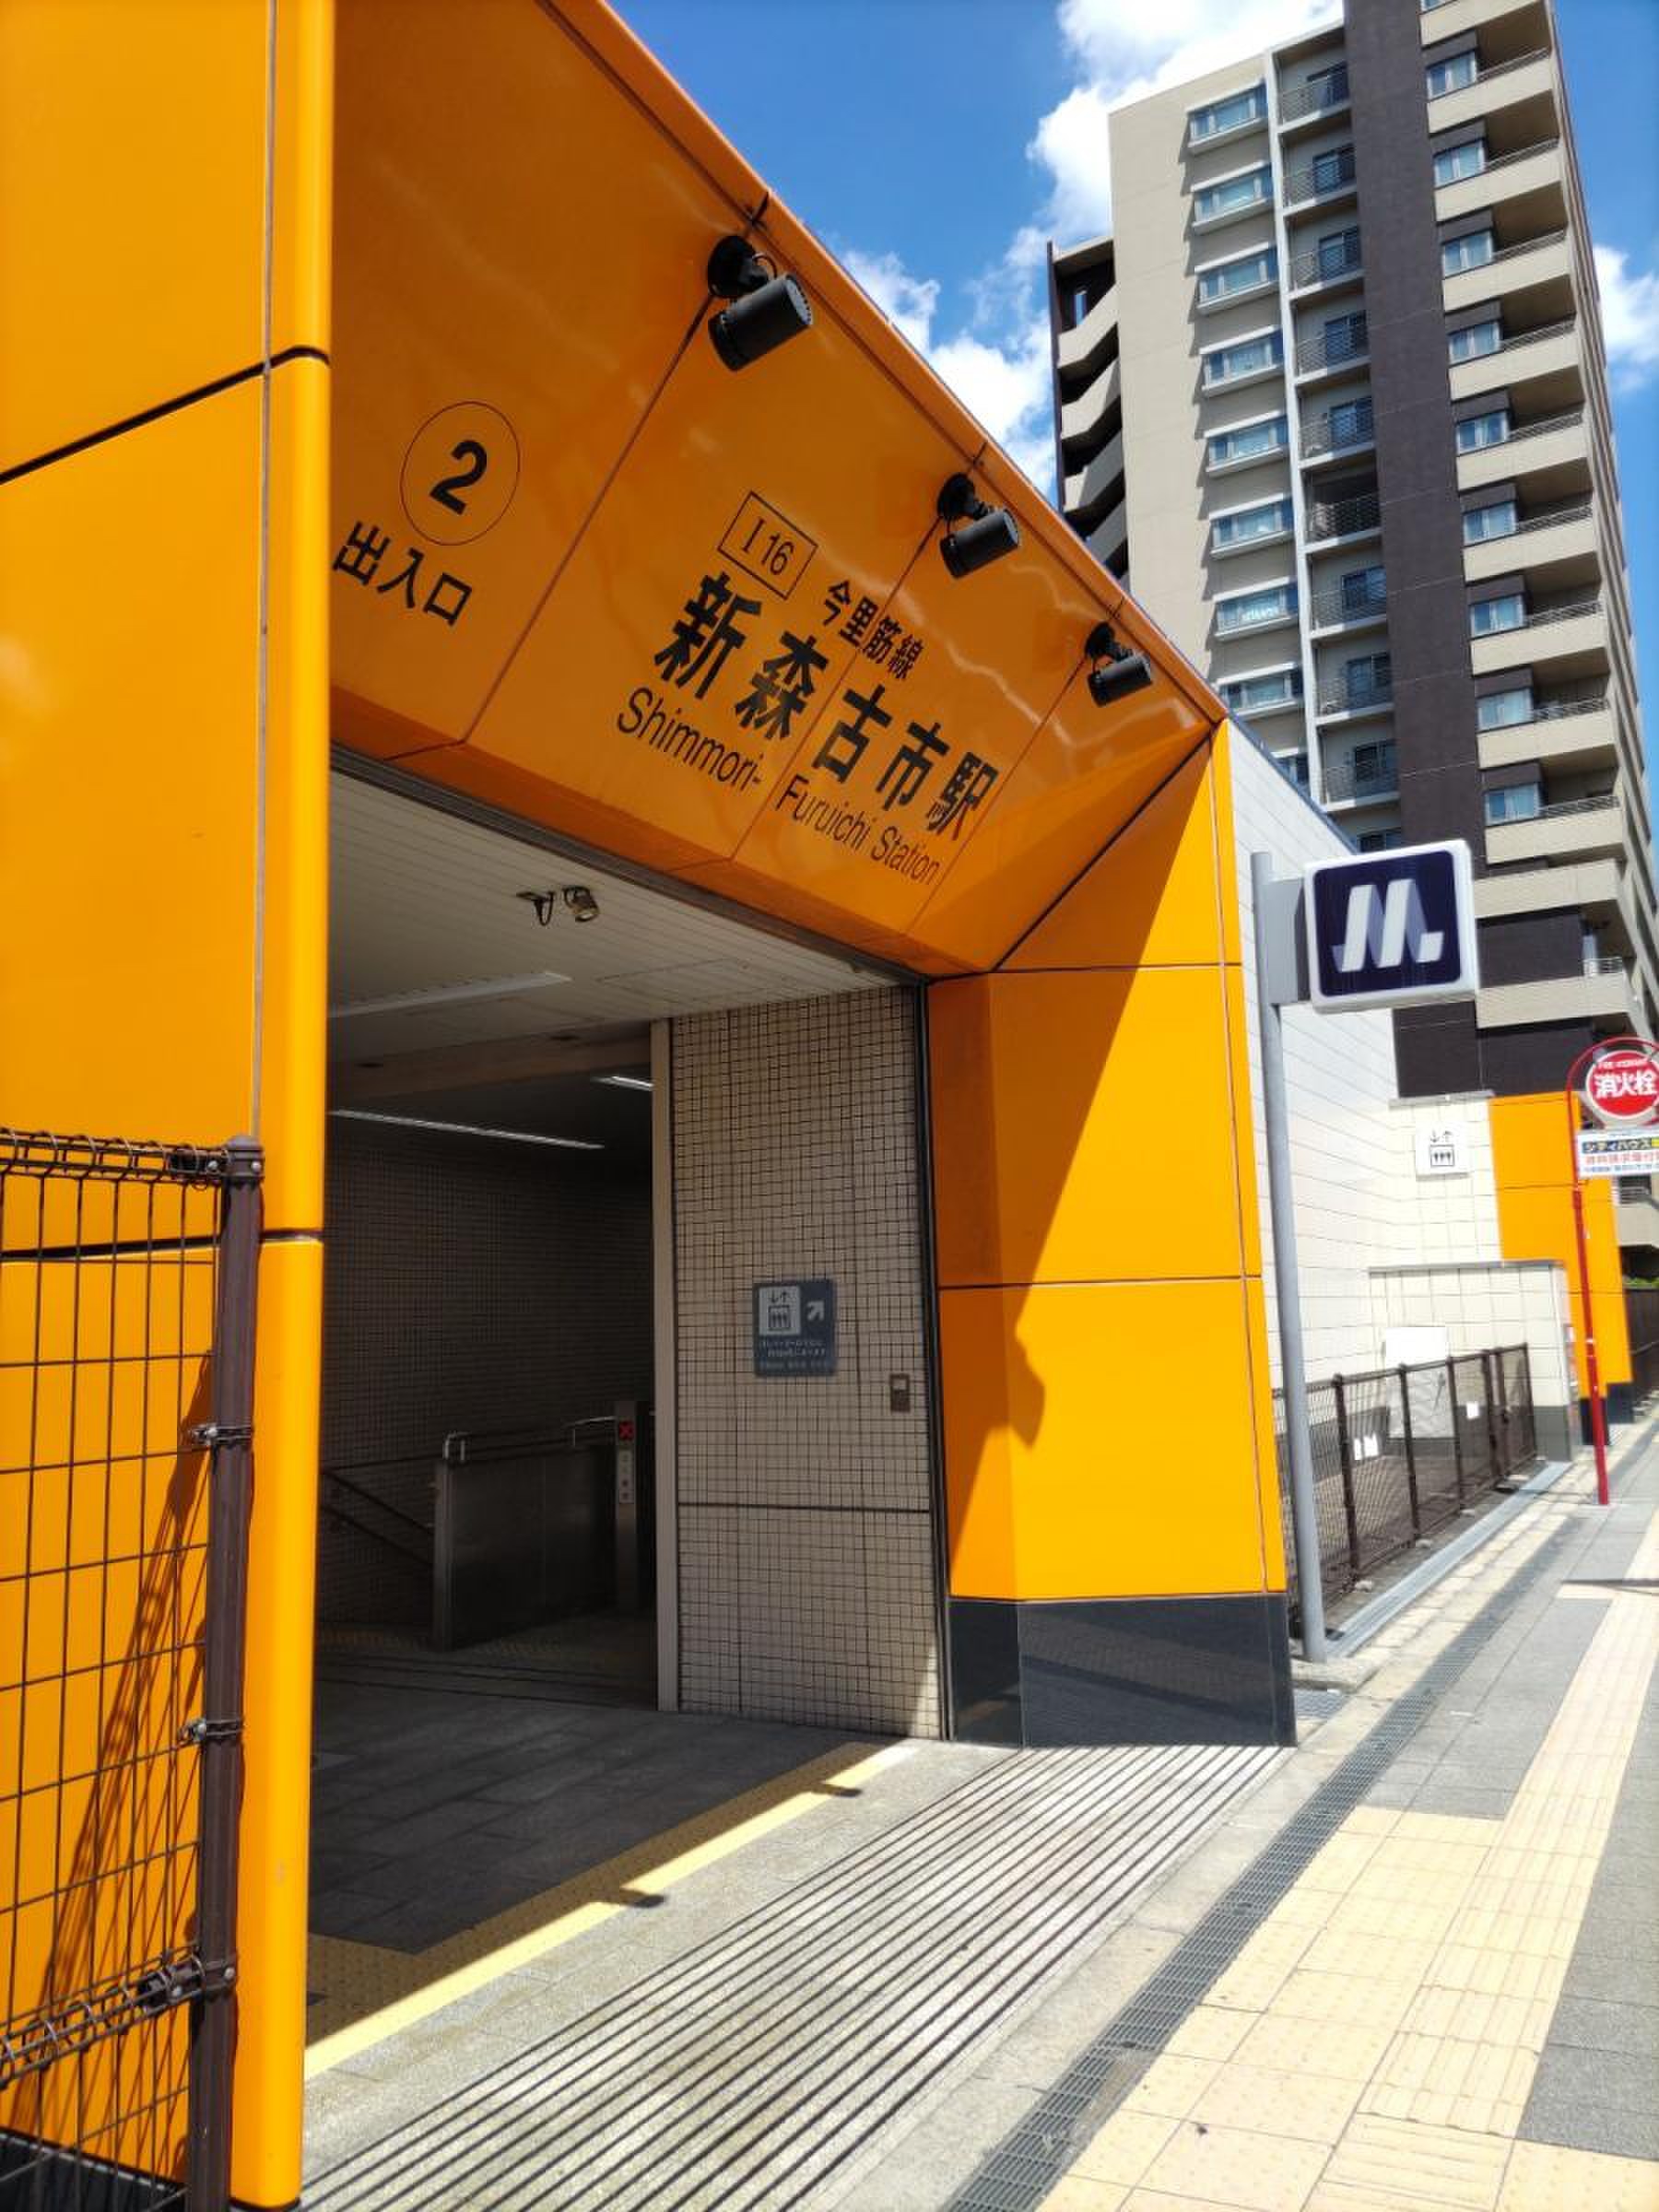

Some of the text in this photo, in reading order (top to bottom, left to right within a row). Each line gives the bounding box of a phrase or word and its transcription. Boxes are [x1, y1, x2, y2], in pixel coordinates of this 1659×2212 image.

[429, 440, 488, 515] 2
[333, 521, 472, 627] 出入口
[822, 580, 924, 680] 今里筋線
[653, 571, 998, 841] 新森古市駅
[617, 688, 941, 886] Shimmori- Furuichi Station
[1594, 1068, 1658, 1099] 消火栓
